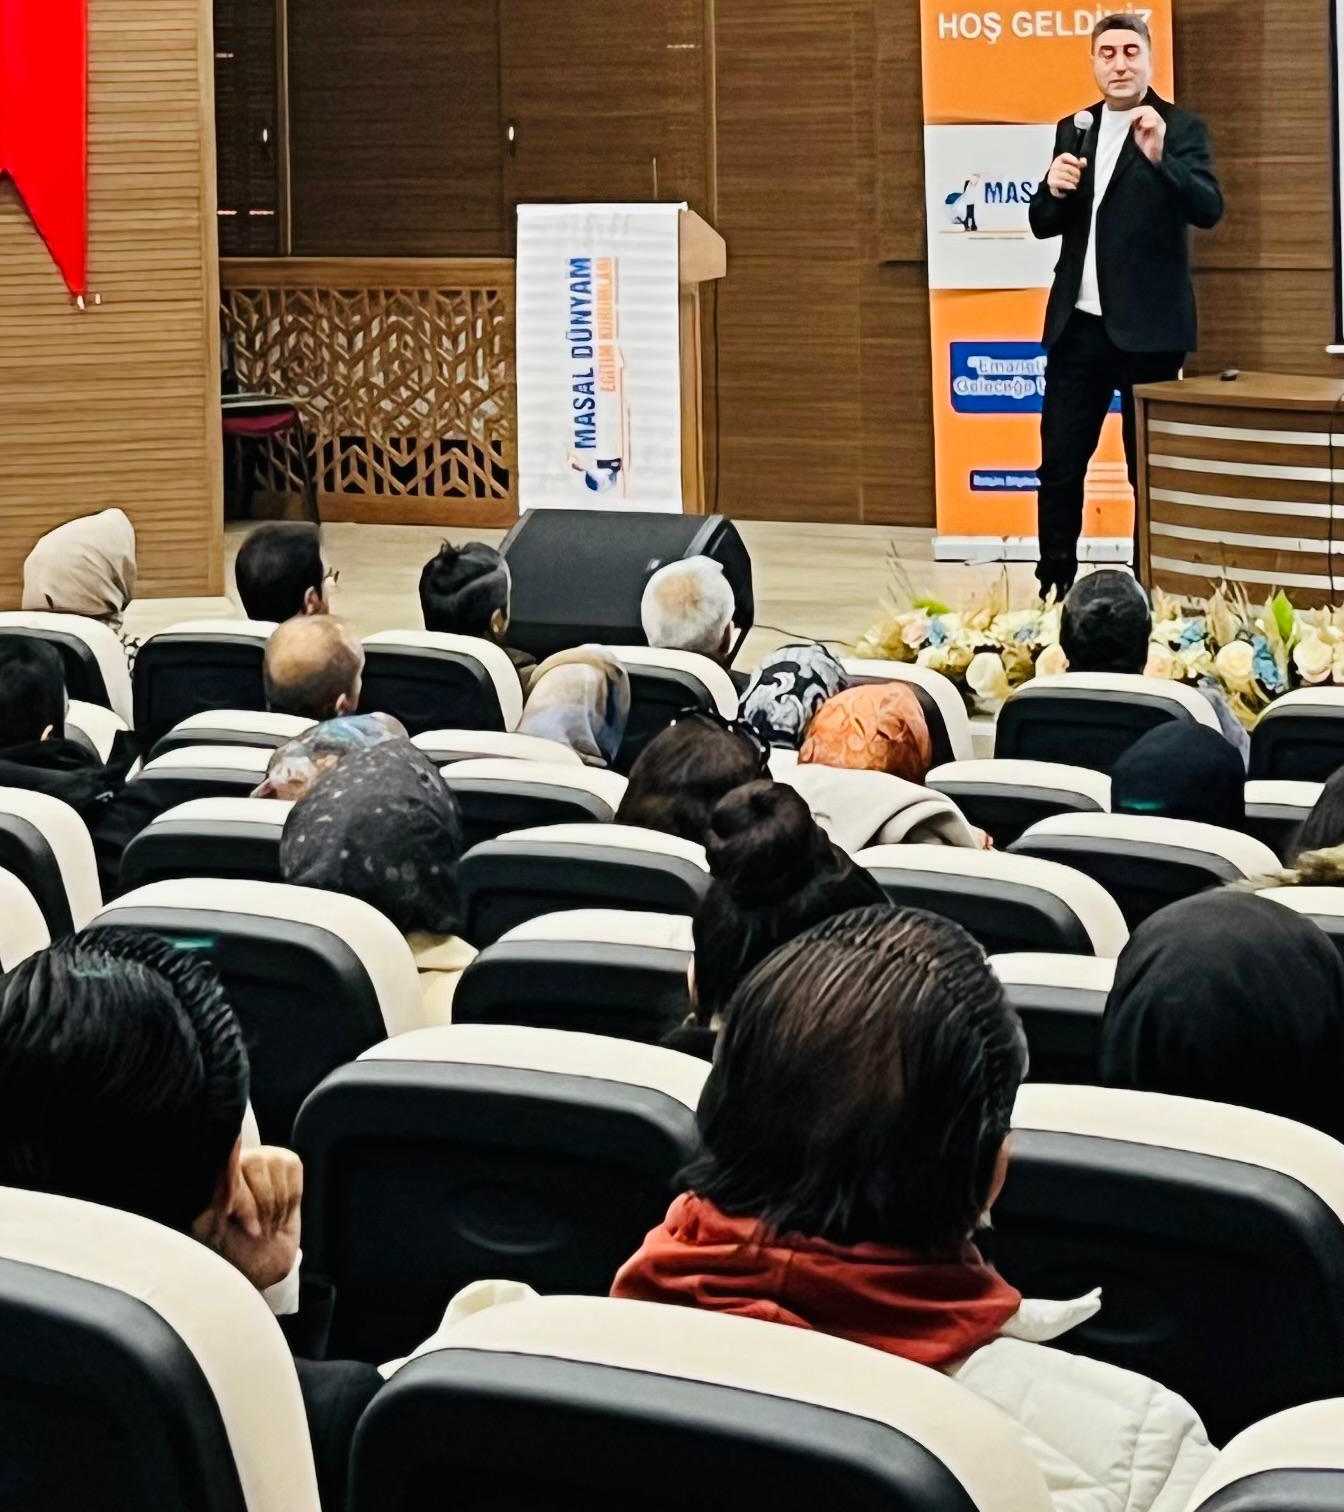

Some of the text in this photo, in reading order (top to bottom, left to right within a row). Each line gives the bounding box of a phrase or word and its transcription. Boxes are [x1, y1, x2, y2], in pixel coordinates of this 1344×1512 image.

[937, 10, 1003, 45] HOŞ
[984, 181, 1033, 204] MAS
[566, 257, 597, 450] MASAL DÜNYAM
